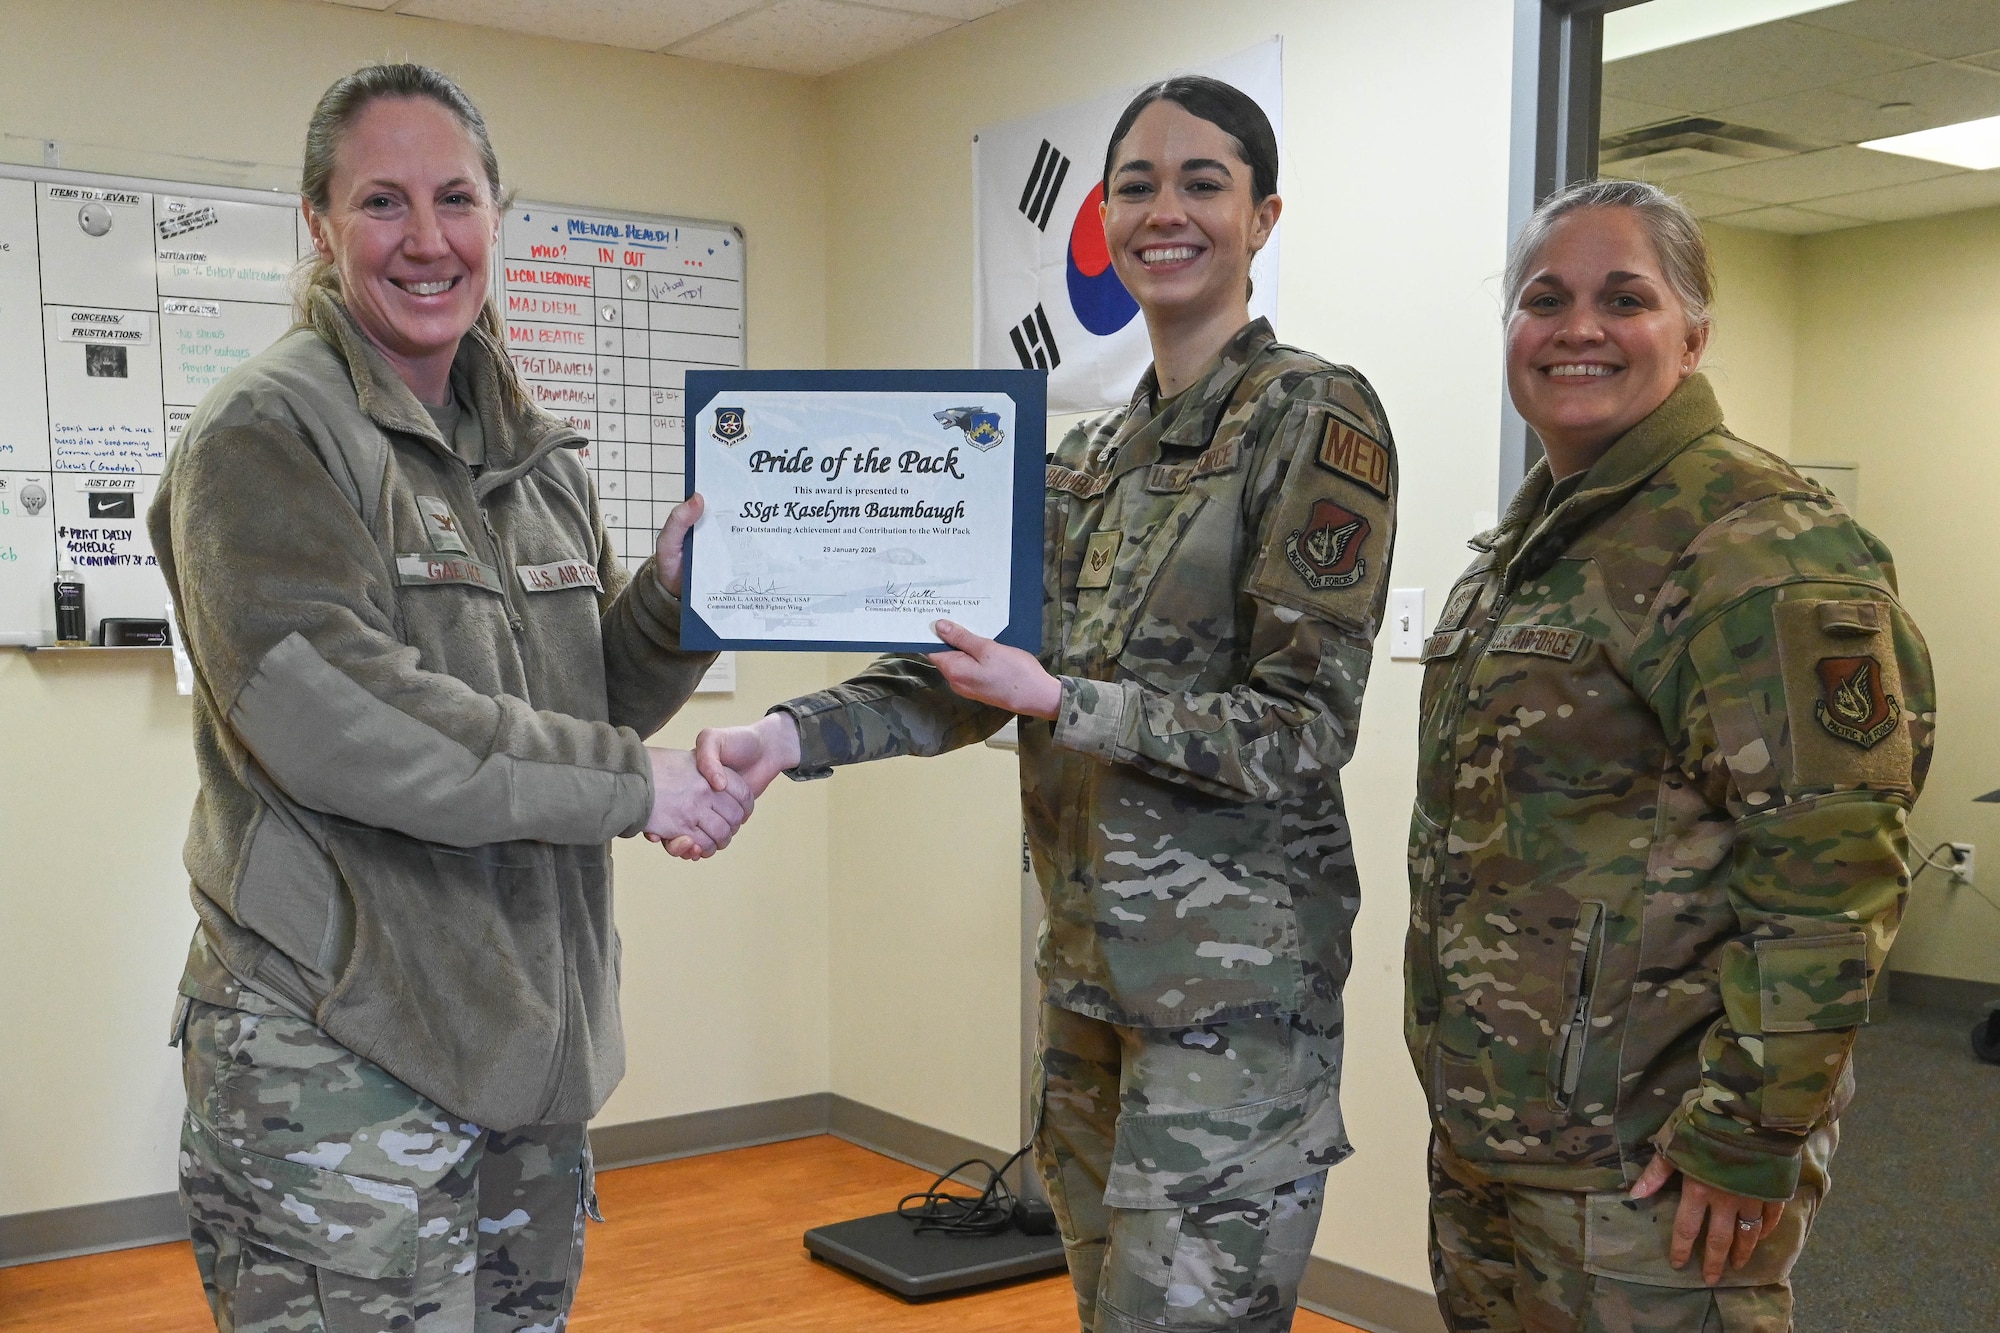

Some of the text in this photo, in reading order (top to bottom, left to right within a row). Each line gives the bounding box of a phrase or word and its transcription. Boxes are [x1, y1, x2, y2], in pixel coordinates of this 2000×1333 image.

[50, 188, 79, 198] ITEMS
[81, 191, 93, 200] TO
[567, 219, 624, 238] MENTAL
[159, 251, 207, 262] SITUATION:
[531, 244, 567, 260] WHO?
[598, 247, 614, 263] IN
[624, 250, 646, 267] OUT
[165, 303, 188, 312] ROOT
[509, 296, 581, 316] MAJ DIEHL
[71, 312, 125, 324] CONCERNS/
[72, 328, 142, 339] FRUSTRATIONS:
[509, 326, 585, 345] MAJ BEATTIE
[169, 412, 192, 420] COUN
[1324, 420, 1384, 486] MED
[749, 447, 965, 481] Pride of the Pack
[123, 480, 135, 488] IT!
[793, 486, 909, 496] This award is presented to
[740, 500, 965, 524] SSgt Kaselynn Baumbaugh
[731, 525, 971, 535] For Outstanding Achievement and Contribution to the Wolf Pack
[832, 546, 859, 554] January
[558, 565, 581, 585] AIR
[1289, 549, 1354, 586] PACIFIC AIR FORCES
[1530, 629, 1577, 656] FORCE
[1827, 717, 1895, 745] PACIFIC AIR FORCES
